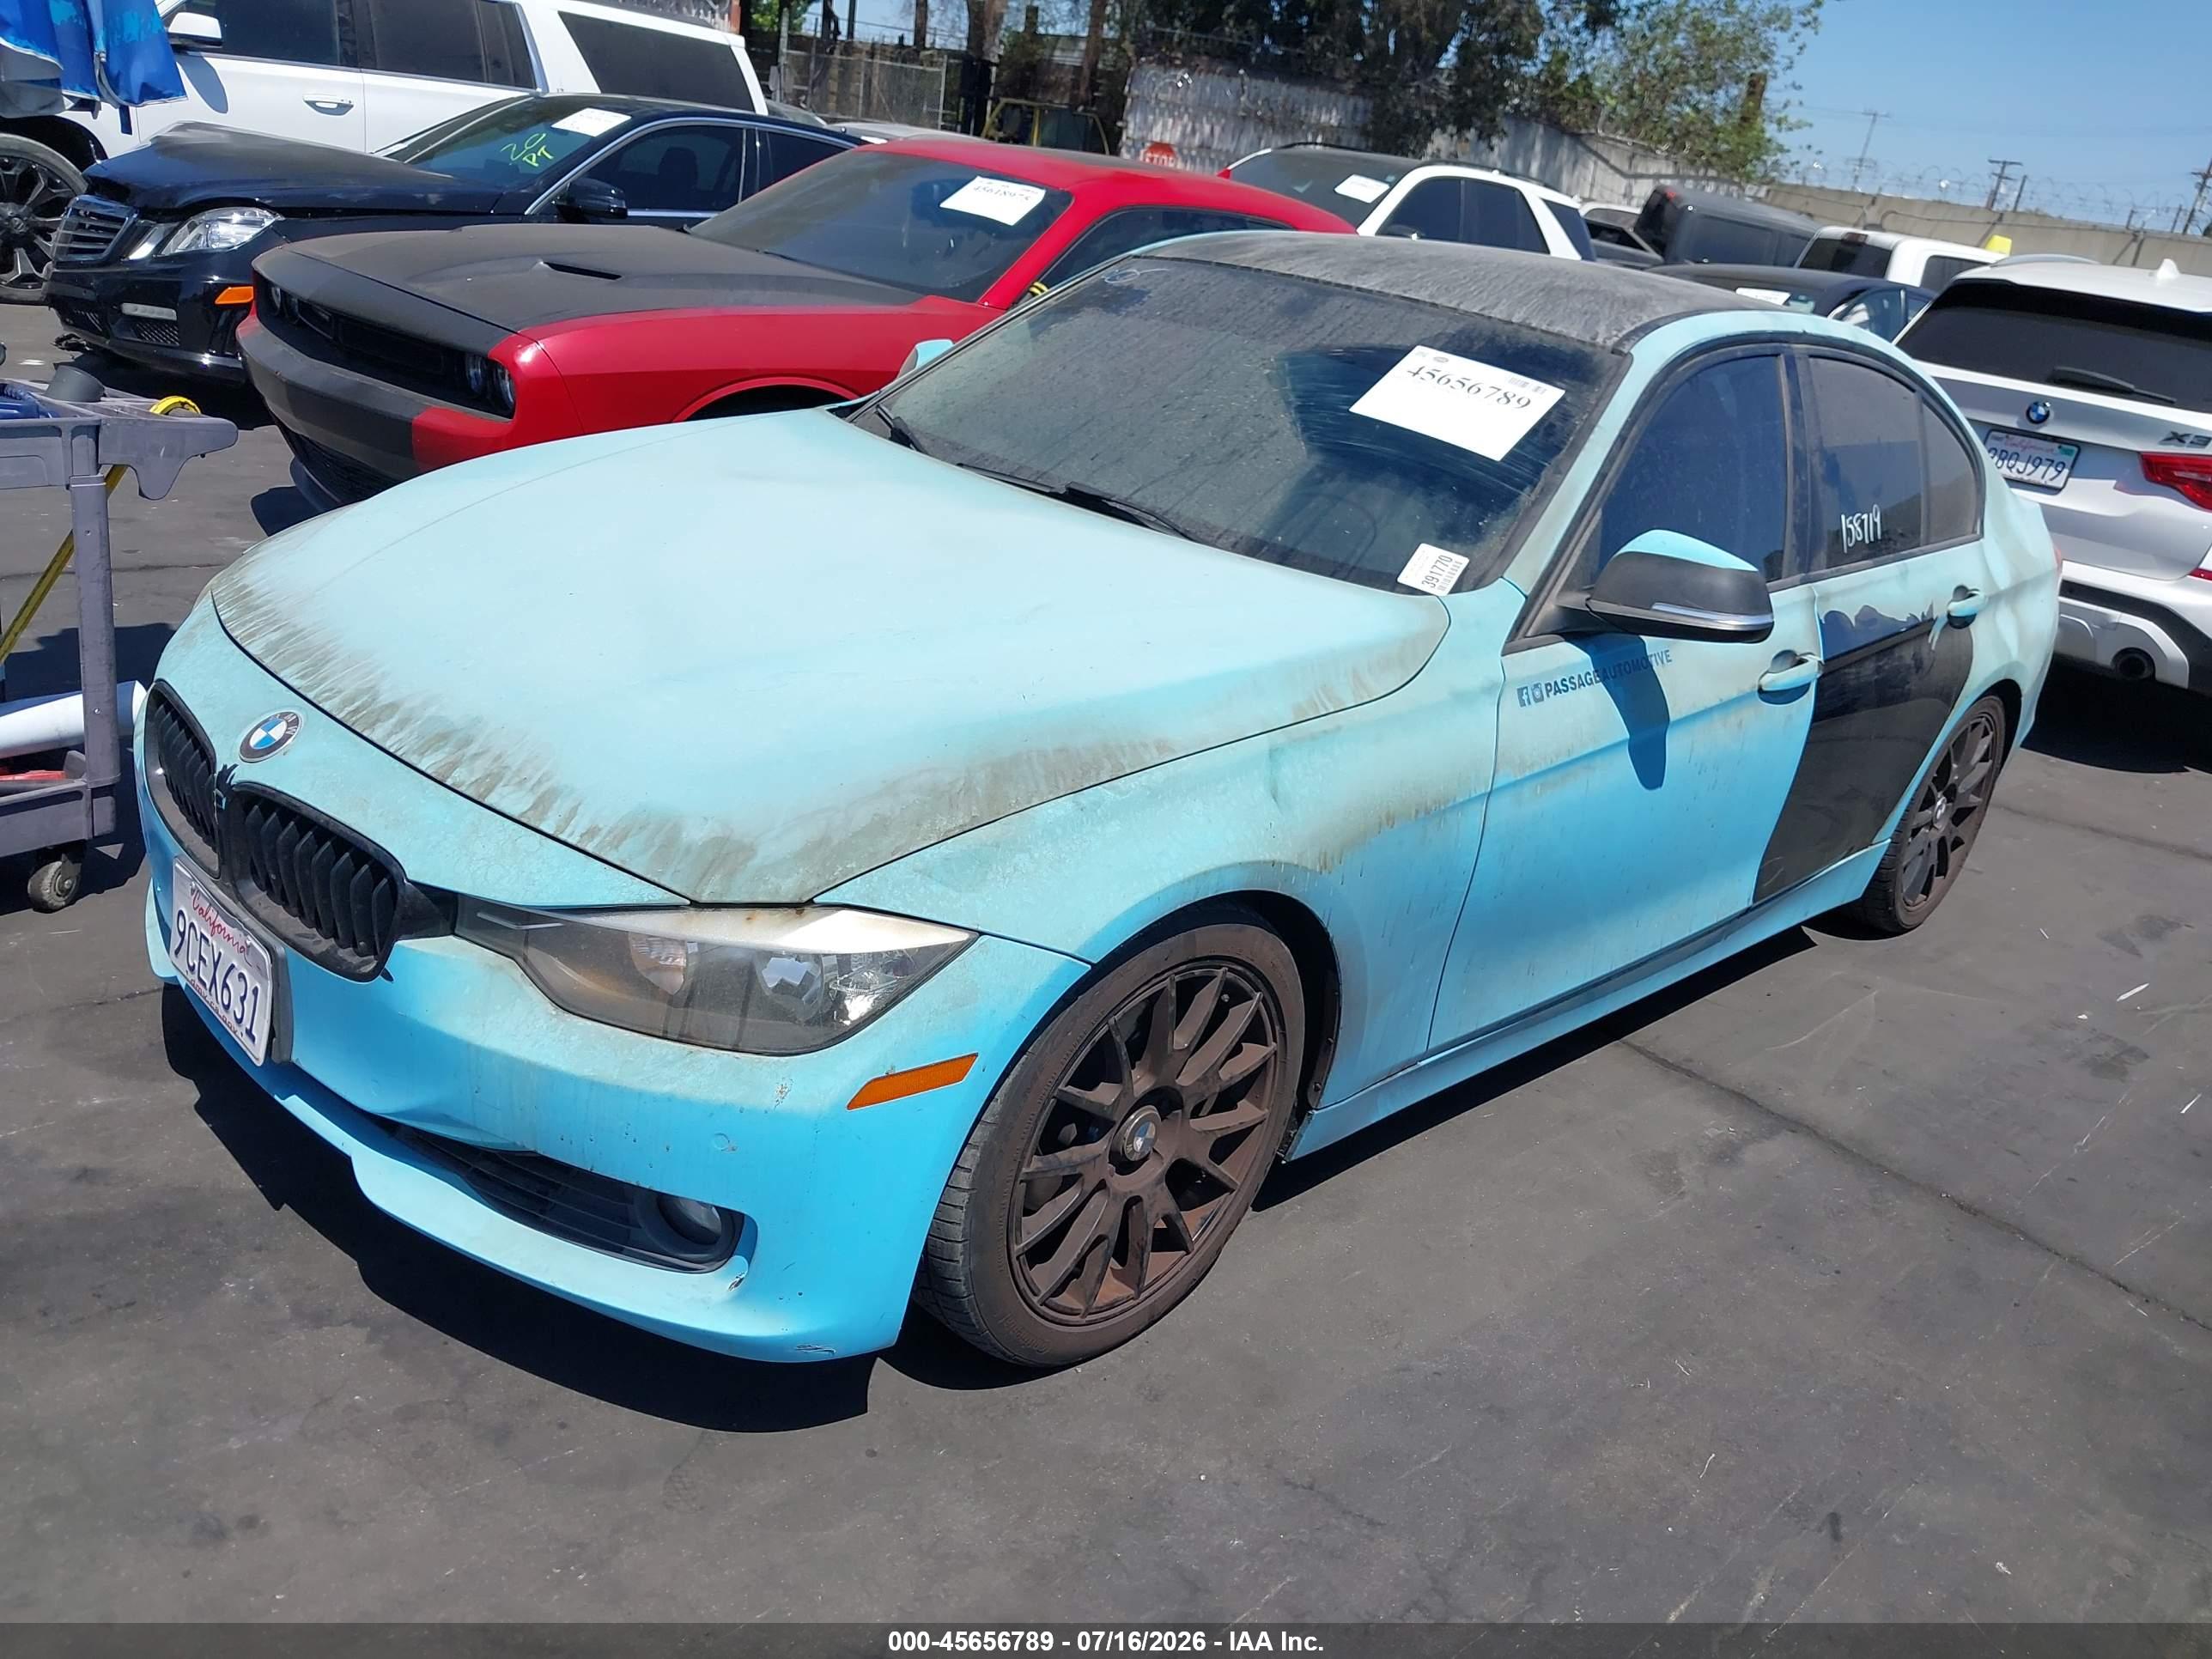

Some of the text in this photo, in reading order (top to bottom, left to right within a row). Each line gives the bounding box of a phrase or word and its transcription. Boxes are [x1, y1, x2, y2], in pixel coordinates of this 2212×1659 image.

[1407, 366, 1531, 410] 45656789
[2160, 431, 2212, 447] X3
[1421, 555, 1453, 589] 391770
[191, 888, 252, 968] California
[174, 909, 261, 1045] 9CEX631
